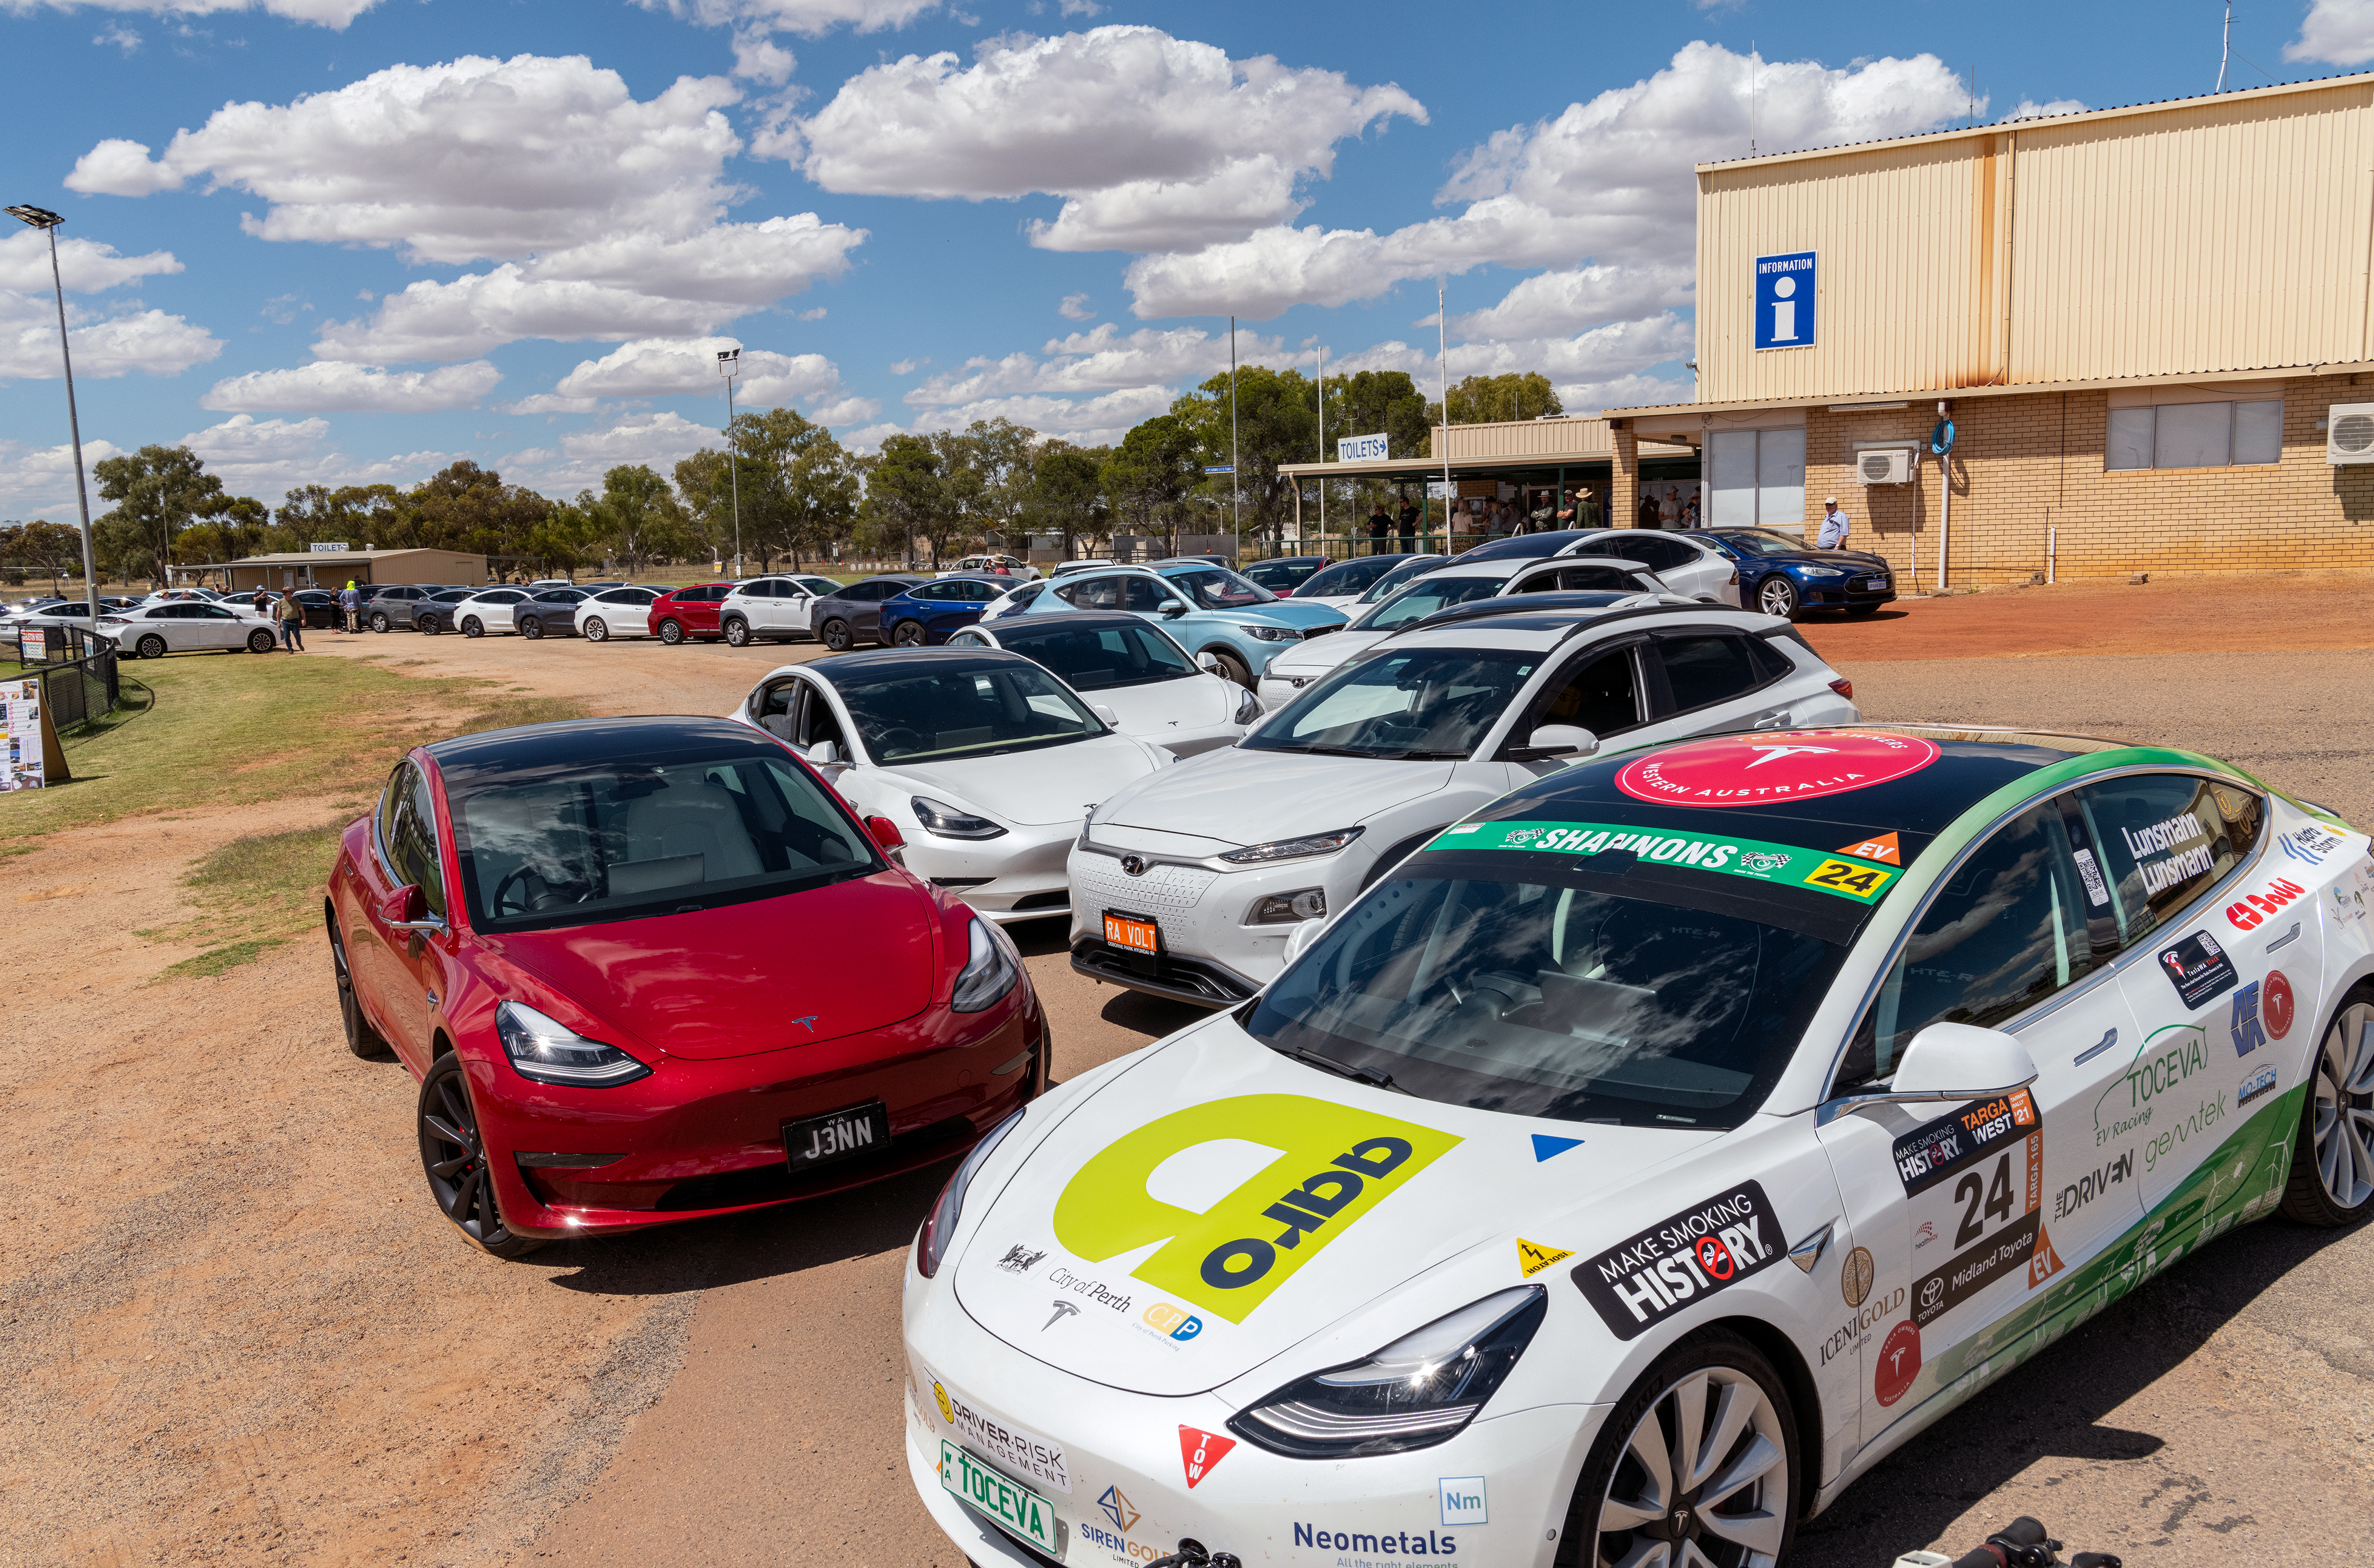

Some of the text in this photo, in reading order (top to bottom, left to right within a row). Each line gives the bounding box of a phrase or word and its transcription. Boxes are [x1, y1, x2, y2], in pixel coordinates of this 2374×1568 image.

[1759, 258, 1812, 274] INFORMATION
[1341, 439, 1379, 459] TOILETS
[1733, 732, 1908, 750] TESLA OWNERS
[1642, 762, 1865, 797] WESTERN AUSTRALIA
[1535, 828, 1738, 868] SHANNONS
[1853, 842, 1896, 859] EV
[2121, 812, 2203, 860] Lunsmann
[2292, 827, 2322, 845] Hydra
[2310, 837, 2344, 854] Storm
[1812, 864, 1881, 892] 24
[2136, 844, 2215, 895] Lunsmann
[1107, 920, 1155, 949] RA VOLT
[1108, 941, 1124, 949] OSBORNE
[2187, 955, 2219, 976] TeslaWA Slack
[2273, 976, 2285, 986] OWNERS
[2267, 1007, 2291, 1034] WESTERN AUSTRALIA
[2127, 1039, 2202, 1108] TOCEVA
[2238, 1068, 2276, 1102] MO-TECH
[2010, 1091, 2027, 1103] TARMAC
[2012, 1099, 2024, 1109] RALLY
[2240, 1086, 2274, 1107] MECHANICAL
[827, 1117, 845, 1126] WA
[1961, 1098, 2009, 1131] TARGA
[1972, 1112, 2012, 1145] WEST
[2096, 1106, 2153, 1147] EV Racing
[805, 1116, 872, 1159] J3NN
[1895, 1124, 1954, 1160] MAKE SMOKING
[2029, 1135, 2039, 1208] TARGA 165
[2055, 1148, 2134, 1223] THE DRIVEN
[1954, 1151, 2014, 1251] 24
[1597, 1194, 1752, 1283] MAKE SMOKING
[1915, 1233, 1939, 1250] healthway
[1527, 1252, 1569, 1274] ISOLATOR
[1952, 1232, 2033, 1292] Midland Toyota
[2033, 1246, 2053, 1281] EV
[1049, 1267, 1132, 1313] City of Perth
[1918, 1300, 1943, 1323] TOYOTA
[1132, 1322, 1143, 1331] City
[1148, 1331, 1161, 1341] Perth
[1161, 1338, 1180, 1352] Parking
[1850, 1333, 1871, 1355] LIMITED
[1883, 1325, 1915, 1354] TESLA OWNERS
[1883, 1381, 1909, 1402] AUSTRALIA
[956, 1417, 1067, 1486] MANAGEMENT
[1189, 1433, 1211, 1480] TOW
[958, 1456, 1045, 1540] TOCEVA
[1447, 1492, 1481, 1510] Nm
[1081, 1523, 1125, 1553] SIREN
[1294, 1521, 1457, 1555] Neometals
[1113, 1554, 1139, 1568] LIMITED
[1337, 1557, 1352, 1568] All
[1355, 1558, 1372, 1568] the
